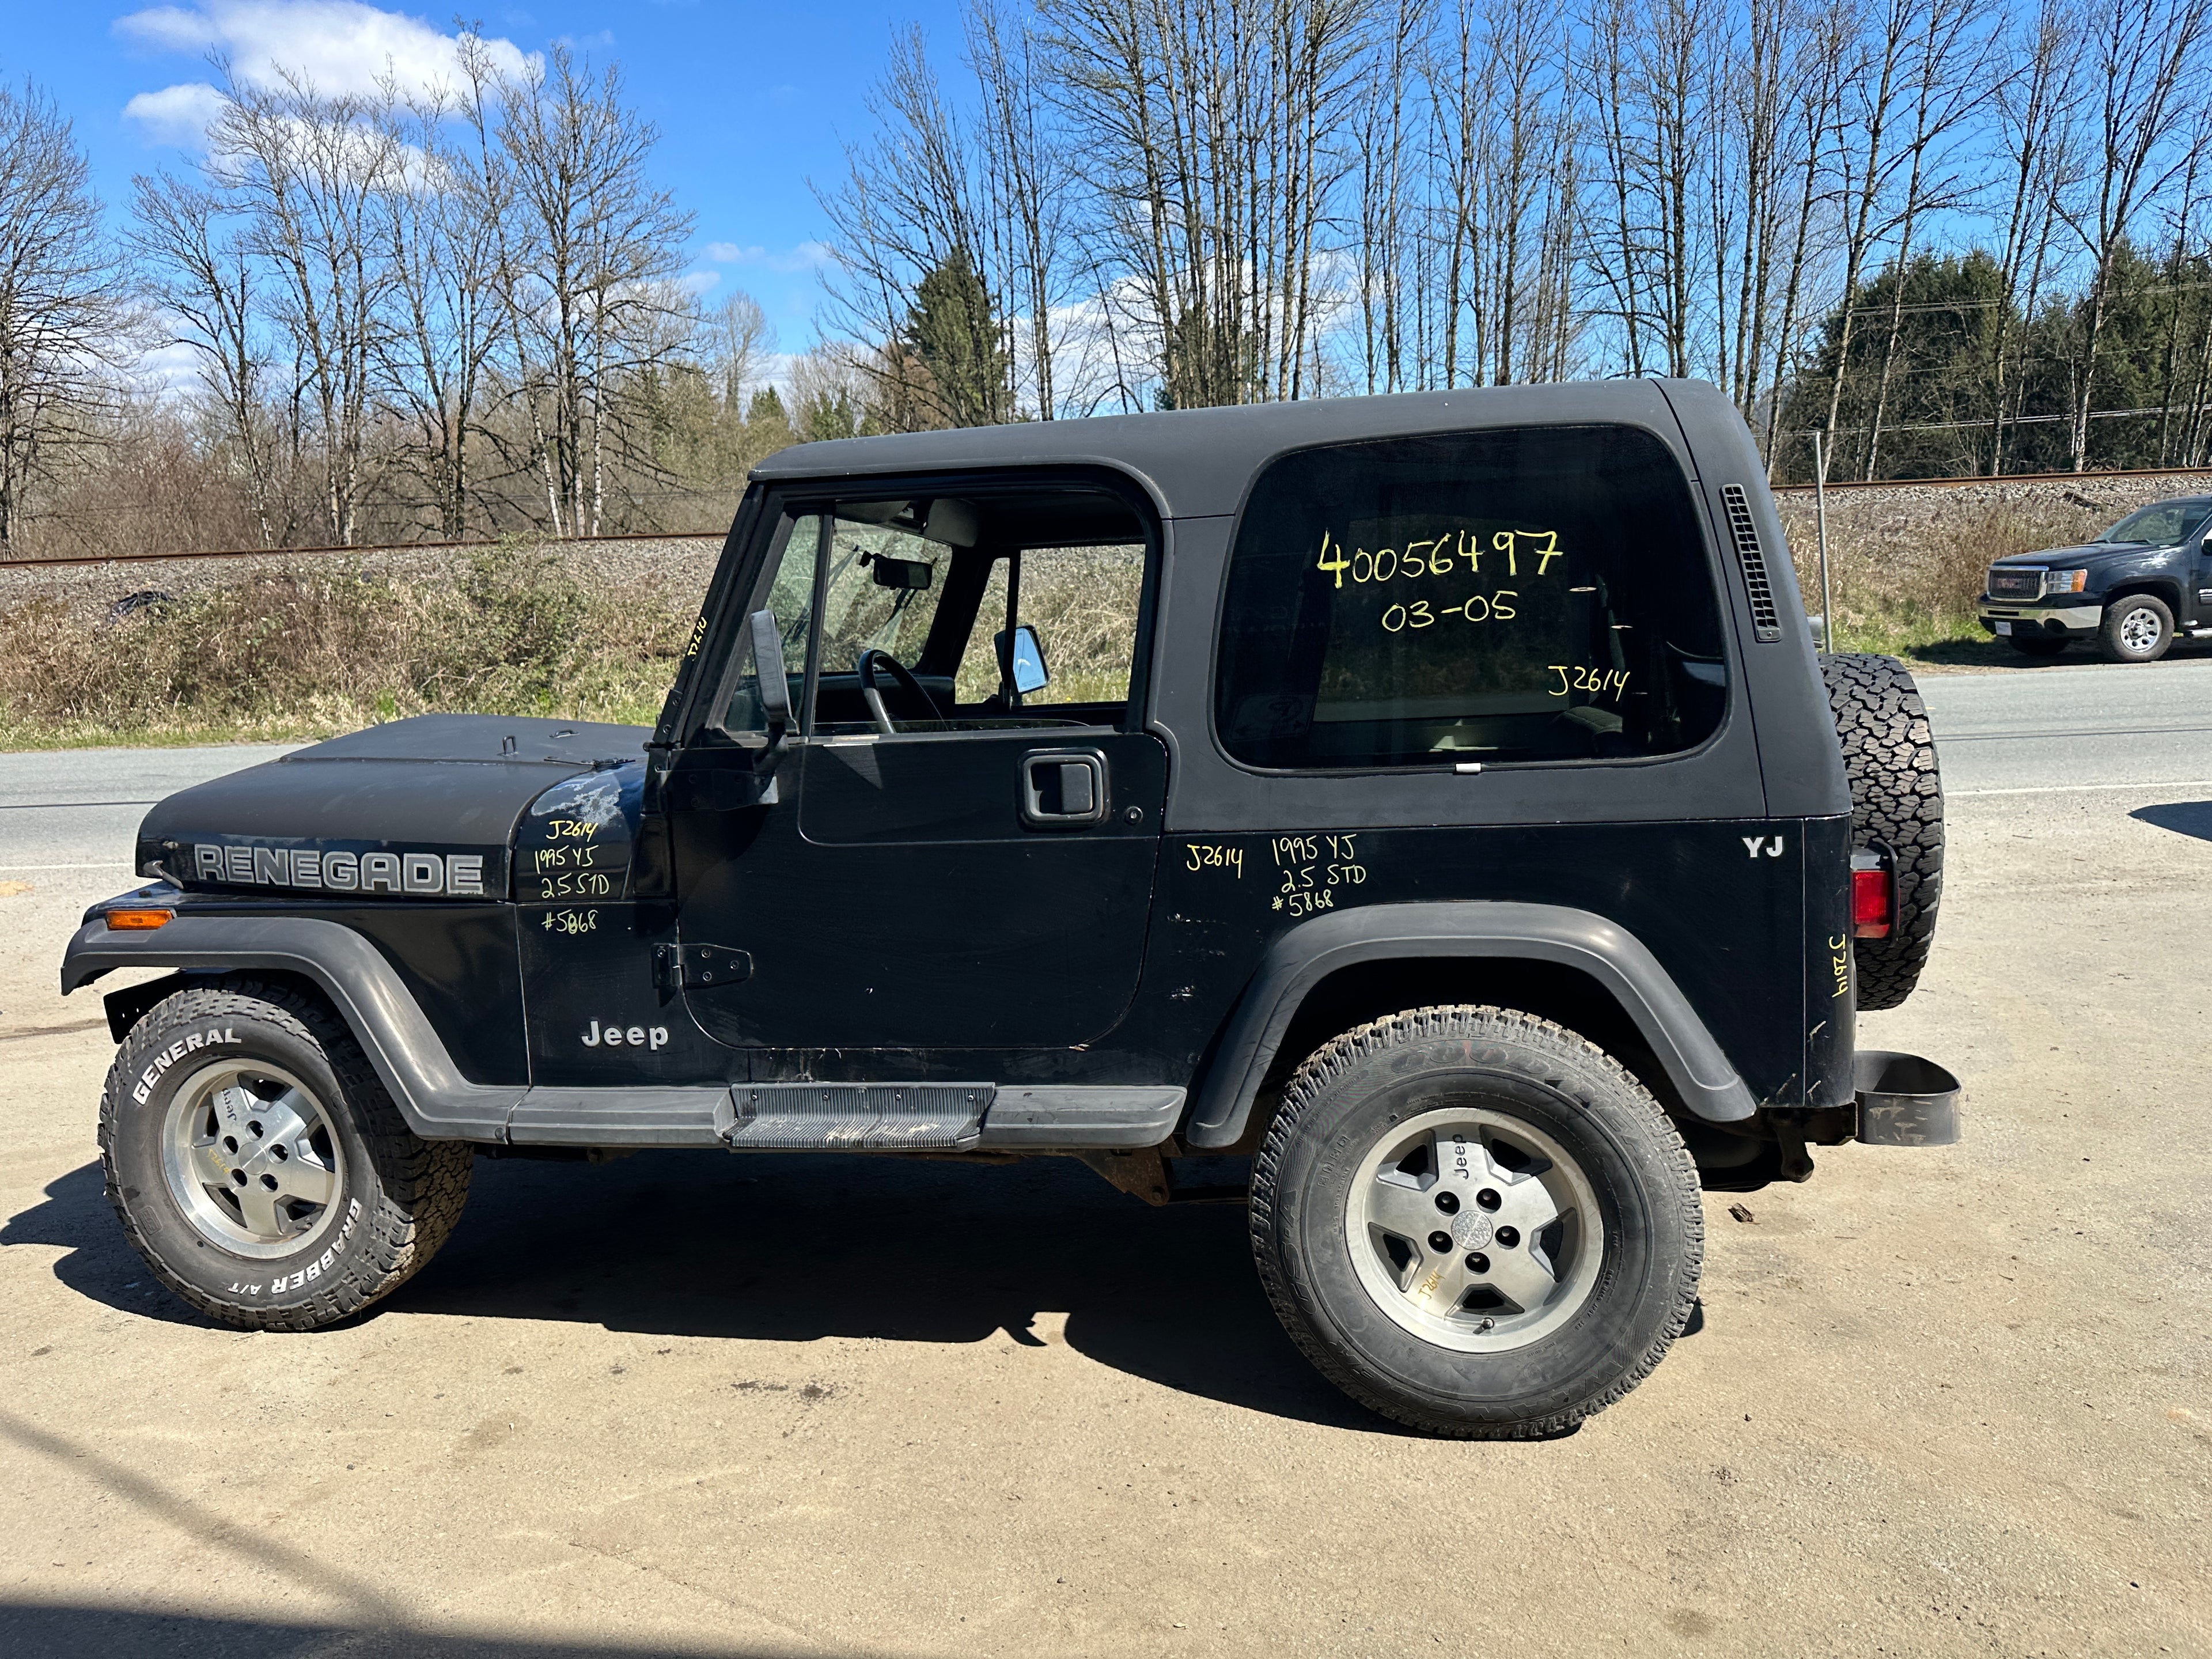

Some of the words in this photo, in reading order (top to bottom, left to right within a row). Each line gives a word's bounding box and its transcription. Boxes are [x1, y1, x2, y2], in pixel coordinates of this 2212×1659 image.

[1317, 528, 1564, 589] 40056497
[1382, 590, 1518, 632] 03-05
[1548, 665, 1630, 702] J2614
[546, 820, 599, 842] J2614
[1742, 835, 1785, 858] YJ
[535, 844, 569, 874] 1995
[1186, 844, 1243, 879] J2614
[1272, 835, 1317, 865] 1995
[1325, 834, 1357, 860] YJ
[194, 843, 483, 895] RENEGADE
[541, 872, 572, 899] 2.5
[575, 873, 609, 894] STD
[1281, 865, 1315, 893] 2.5
[1327, 864, 1366, 884] STD
[1271, 889, 1334, 917] #5868
[1828, 934, 1849, 998] J2614
[581, 1021, 669, 1051] Jeep
[132, 1028, 242, 1105] GENERAL
[220, 1088, 237, 1123] Jeep
[1452, 1134, 1469, 1180] Jeep
[271, 1198, 362, 1295] GRABBER
[228, 1283, 260, 1296] A/T
[1418, 1270, 1446, 1300] J2614
